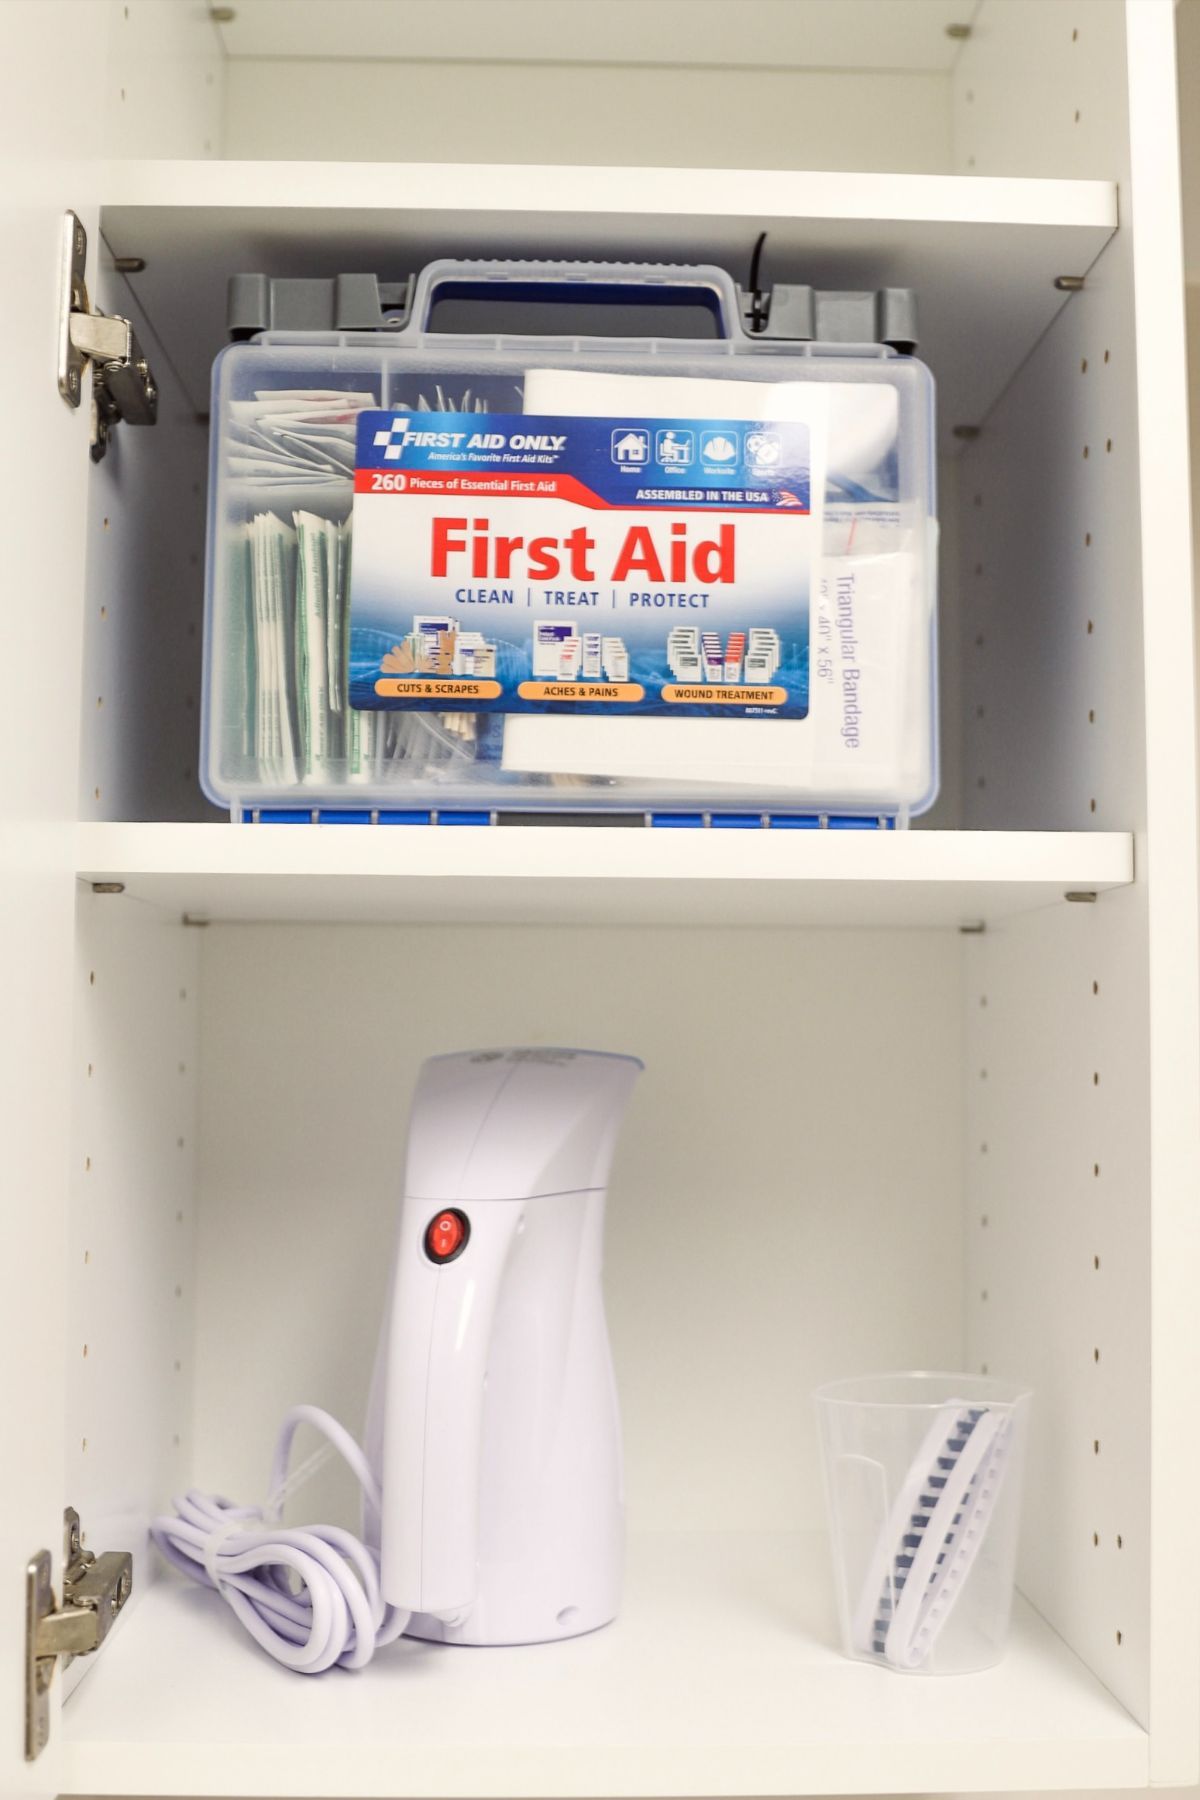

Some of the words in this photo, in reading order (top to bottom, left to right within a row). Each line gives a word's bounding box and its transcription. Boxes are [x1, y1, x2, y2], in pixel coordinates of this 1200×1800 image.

[402, 431, 465, 448] FIRST
[467, 433, 506, 450] AID
[428, 451, 467, 461] America's
[468, 453, 501, 462] Favorite
[502, 454, 520, 463] First
[521, 454, 536, 463] Aid
[620, 466, 642, 474] Home
[665, 466, 686, 474] Office
[371, 473, 407, 491] 260
[409, 478, 444, 489] Pieces
[446, 478, 459, 489] of
[460, 479, 508, 491] Essential
[510, 480, 535, 491] First
[536, 480, 556, 492] Aid
[636, 489, 704, 500] ASSEMBLED
[706, 490, 720, 501] IN
[721, 491, 743, 501] THE
[745, 491, 769, 502] USA
[430, 517, 595, 582] First
[610, 523, 735, 584] Aid
[455, 588, 514, 604] CLEAN
[543, 591, 599, 606] TREAT
[629, 592, 710, 608] PROTECT
[835, 574, 859, 662] Triangular
[817, 646, 829, 655] x
[396, 683, 421, 693] CUTS
[424, 684, 432, 693] &
[434, 684, 479, 694] SCRAPES
[543, 687, 576, 696] ACHES
[578, 687, 586, 697] &
[588, 687, 618, 697] PAINS
[674, 689, 713, 699] WOUND
[716, 690, 774, 700] TREATMENT
[840, 668, 862, 748] Bandage
